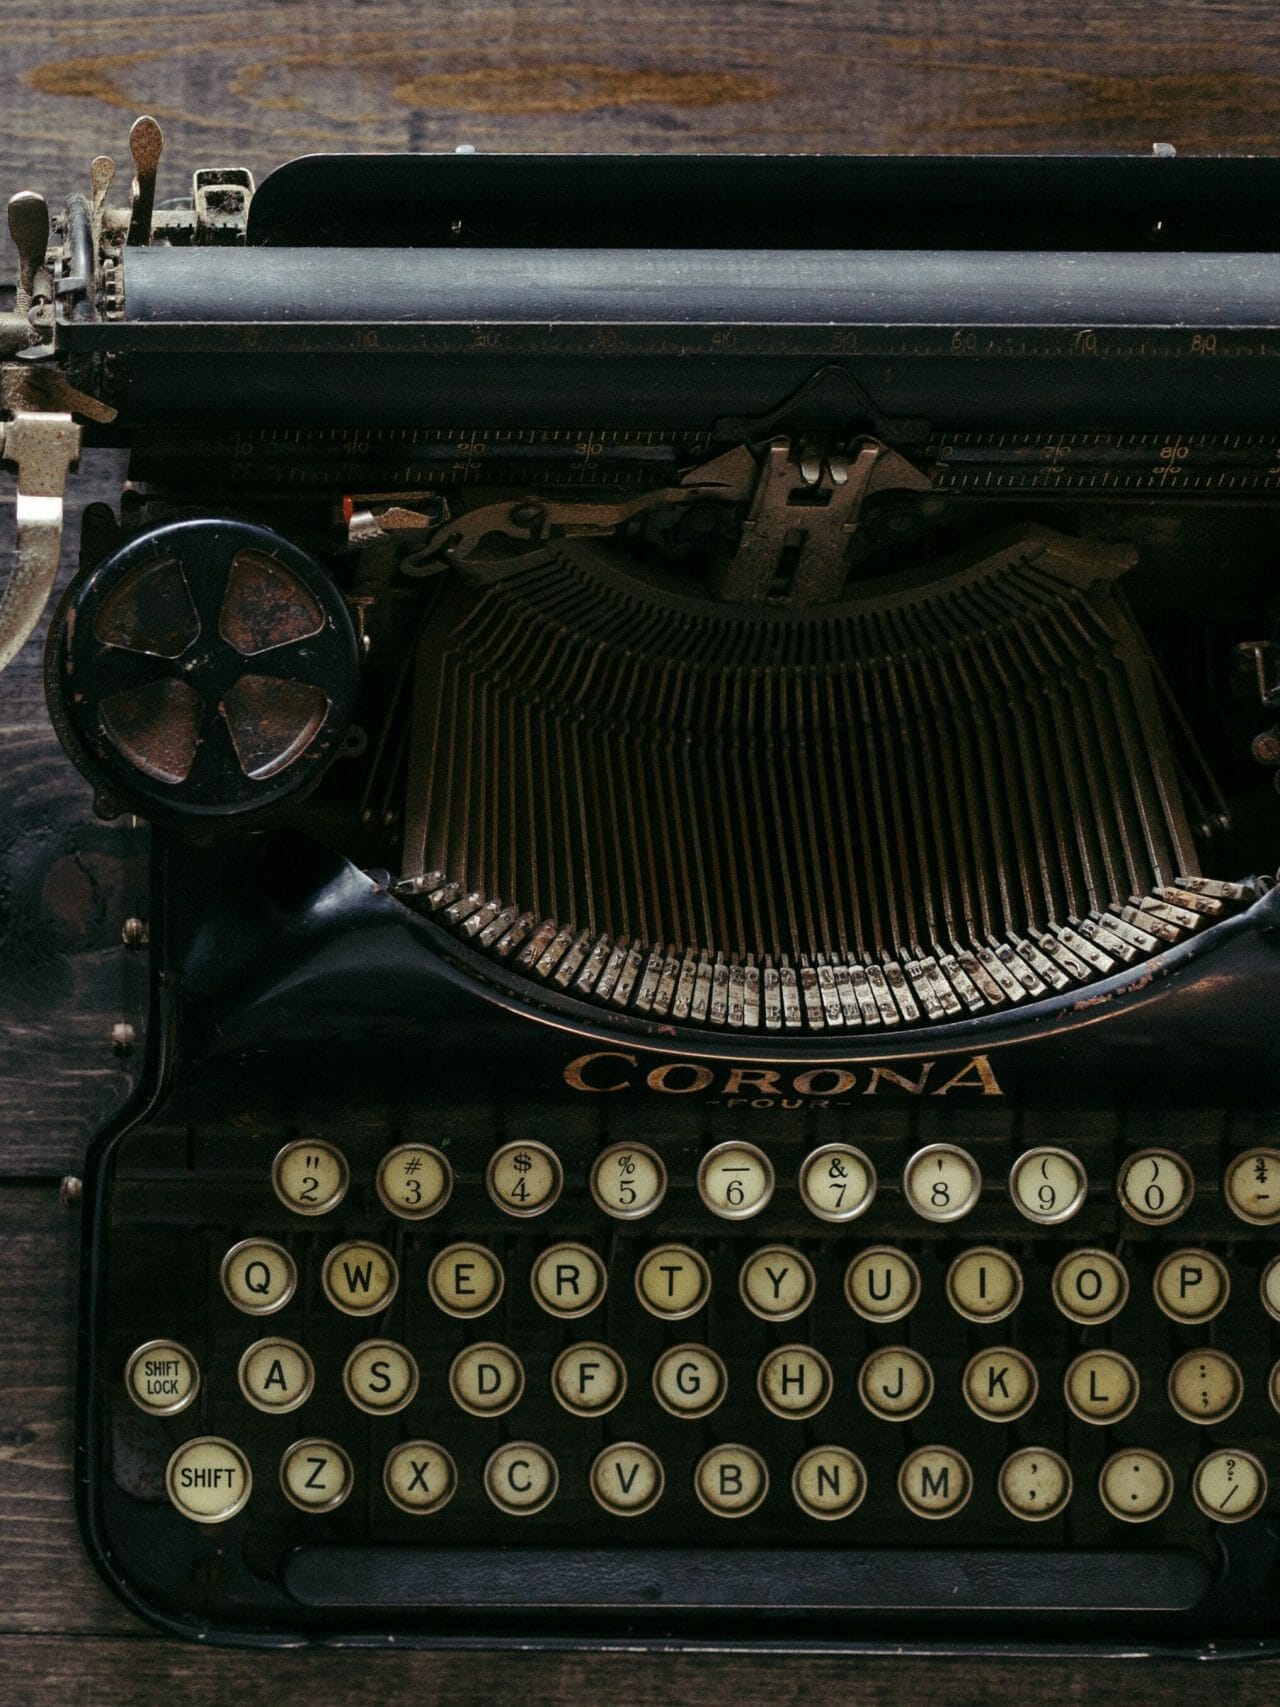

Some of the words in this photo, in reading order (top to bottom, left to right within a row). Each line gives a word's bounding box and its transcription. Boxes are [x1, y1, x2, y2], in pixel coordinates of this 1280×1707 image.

[951, 331, 978, 350] 60
[1190, 333, 1217, 351] 80
[573, 443, 604, 458] 30
[1159, 447, 1190, 462] 80
[563, 1052, 1006, 1096] CORONA
[404, 1157, 422, 1175] #
[513, 1152, 532, 1172] $
[618, 1154, 635, 1176] %
[828, 1158, 849, 1178] &
[1041, 1159, 1048, 1180] (
[1151, 1160, 1159, 1182] )
[300, 1177, 318, 1202] 2
[405, 1180, 421, 1204] 3
[511, 1177, 530, 1201] 4
[619, 1180, 636, 1204] 5
[727, 1180, 744, 1205] 6
[830, 1183, 846, 1208] 7
[931, 1182, 950, 1206] 8
[1038, 1185, 1055, 1210] 9
[1145, 1185, 1164, 1210] 0
[245, 1261, 270, 1295] Q
[343, 1261, 372, 1293] W
[455, 1264, 475, 1294] E
[557, 1265, 580, 1295] R
[660, 1266, 683, 1296] T
[765, 1267, 788, 1298] Y
[868, 1269, 891, 1301] U
[979, 1267, 986, 1298] I
[1076, 1269, 1102, 1300] O
[1181, 1265, 1202, 1298] P
[145, 1360, 180, 1377] SHIFT
[264, 1360, 287, 1391] A
[369, 1362, 391, 1393] S
[478, 1364, 501, 1394] D
[579, 1363, 600, 1393] F
[677, 1363, 700, 1394] G
[782, 1364, 804, 1395] H
[883, 1368, 903, 1399] J
[988, 1367, 1010, 1398] K
[147, 1380, 178, 1395] LOCK
[1090, 1371, 1108, 1401] L
[181, 1468, 236, 1488] SHIFT
[305, 1457, 327, 1489] Z
[408, 1461, 429, 1492] X
[508, 1460, 532, 1492] C
[616, 1463, 640, 1493] V
[720, 1464, 742, 1495] B
[818, 1465, 840, 1496] N
[922, 1467, 948, 1498] M
[1226, 1458, 1237, 1482] ?
